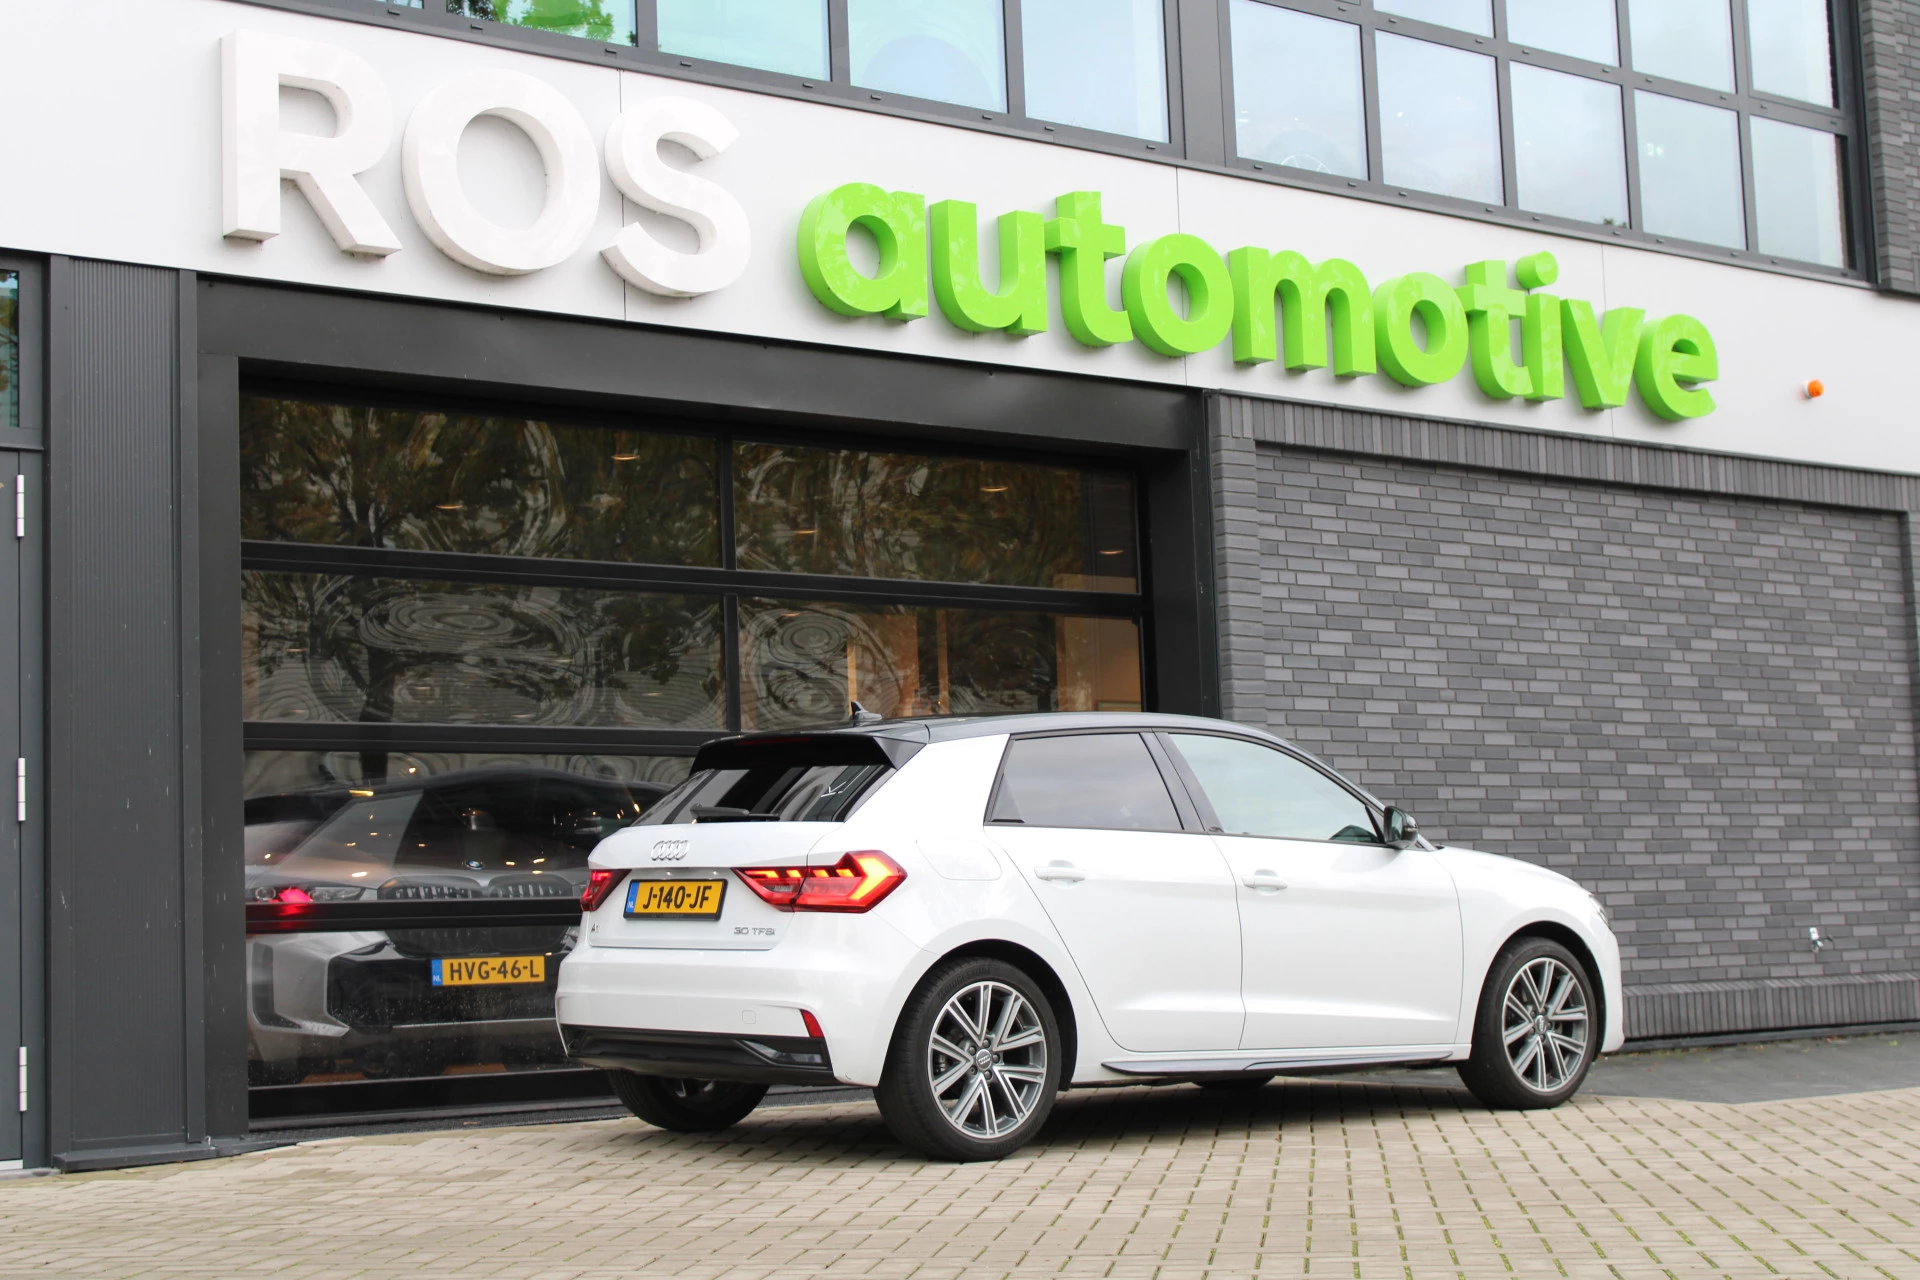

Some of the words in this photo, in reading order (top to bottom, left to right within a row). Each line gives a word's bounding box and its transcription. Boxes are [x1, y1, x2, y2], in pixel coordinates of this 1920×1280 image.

[221, 29, 752, 298] ROS
[798, 182, 1719, 423] automotive
[643, 886, 712, 910] J-140-JF
[733, 926, 750, 935] 30
[449, 960, 540, 981] HVG-46-L
